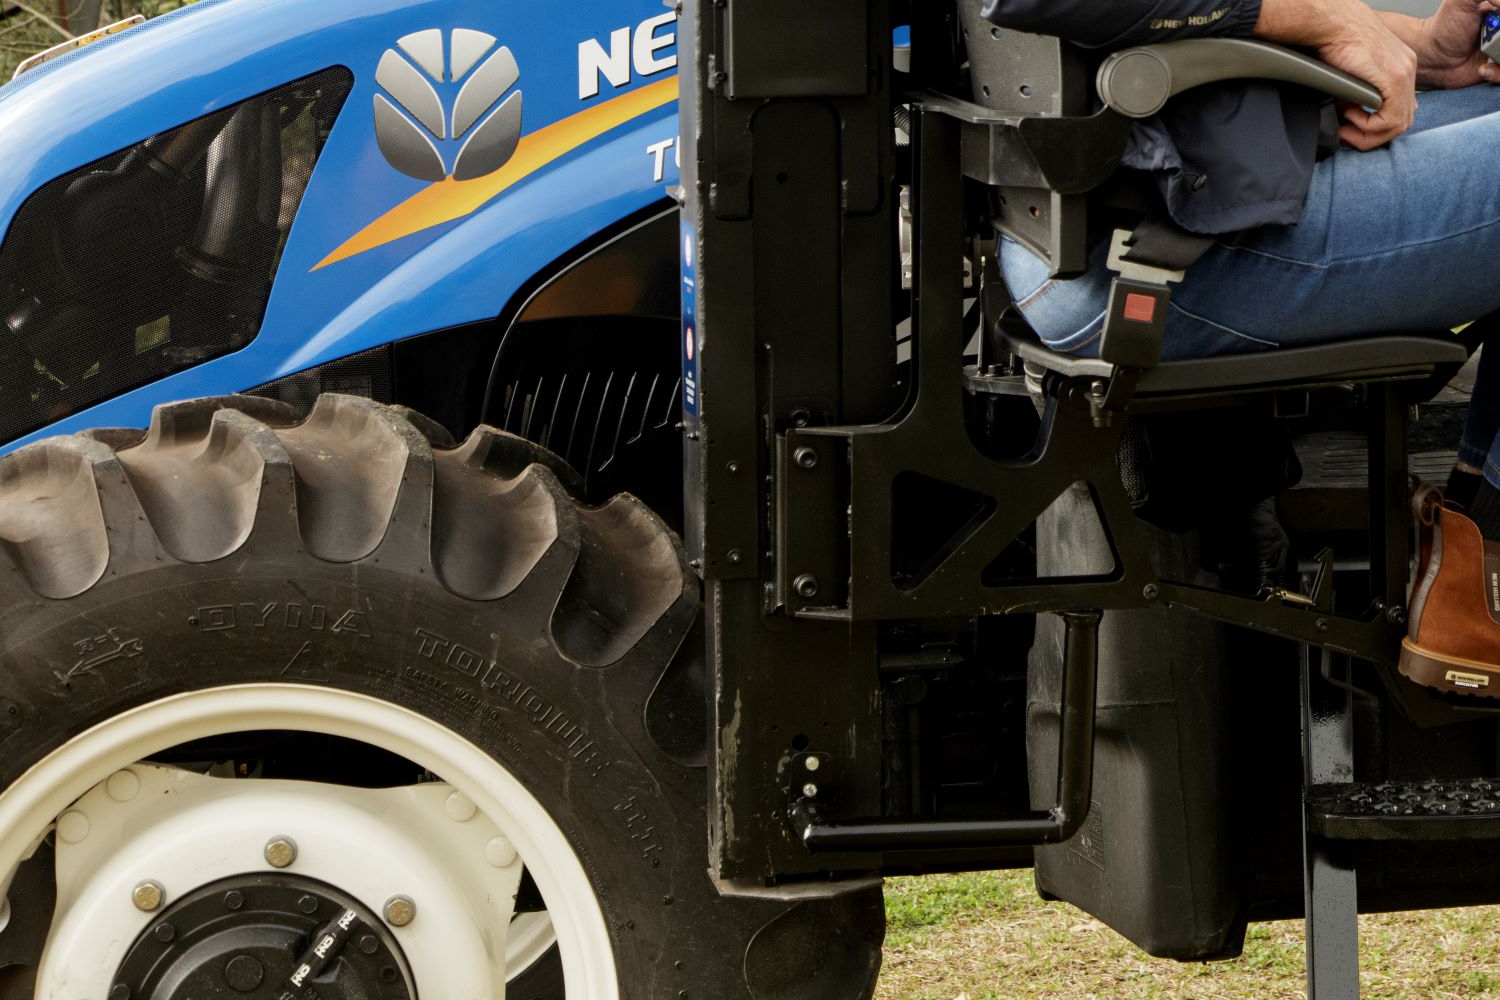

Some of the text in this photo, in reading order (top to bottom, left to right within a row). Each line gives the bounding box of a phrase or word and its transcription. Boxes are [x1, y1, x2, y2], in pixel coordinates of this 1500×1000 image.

[646, 135, 681, 184] T
[197, 601, 372, 641] DYNA
[414, 626, 613, 780] TORQUE
[406, 665, 450, 692] SAFETY
[454, 684, 499, 721] WARNING
